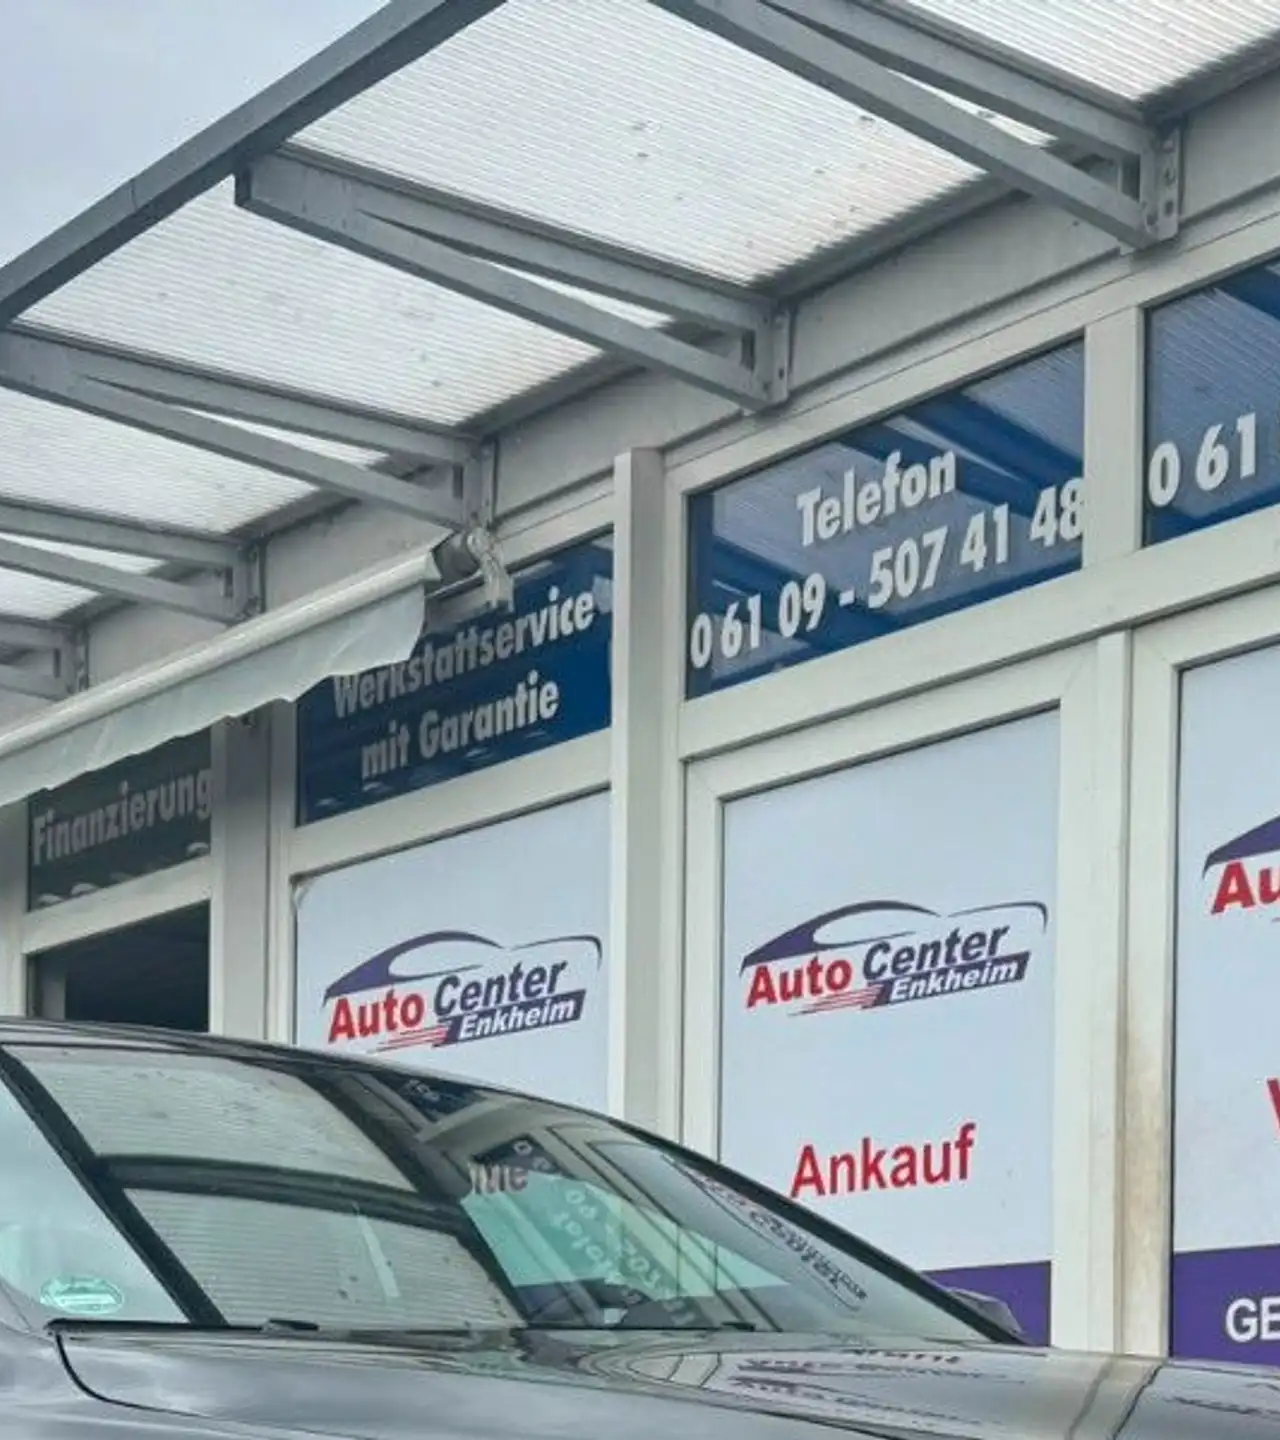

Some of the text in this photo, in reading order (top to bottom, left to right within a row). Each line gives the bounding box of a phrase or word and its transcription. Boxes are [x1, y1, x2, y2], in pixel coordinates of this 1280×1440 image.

[1195, 412, 1257, 492] 61
[797, 450, 957, 547] Telefon
[721, 594, 762, 659] 61
[778, 573, 827, 638] 09
[868, 526, 949, 609] 507
[960, 503, 1010, 572] 41
[1030, 477, 1084, 547] 48
[332, 586, 596, 718] Werkstattservice
[361, 669, 560, 779] mit Garantie
[33, 769, 212, 866] Finanzierung
[328, 960, 569, 1043] Auto Center
[746, 925, 1009, 1008] Auto Center
[890, 958, 1019, 1001] Enkheim
[458, 998, 576, 1041] Enkheim
[791, 1123, 976, 1198] Ankauf
